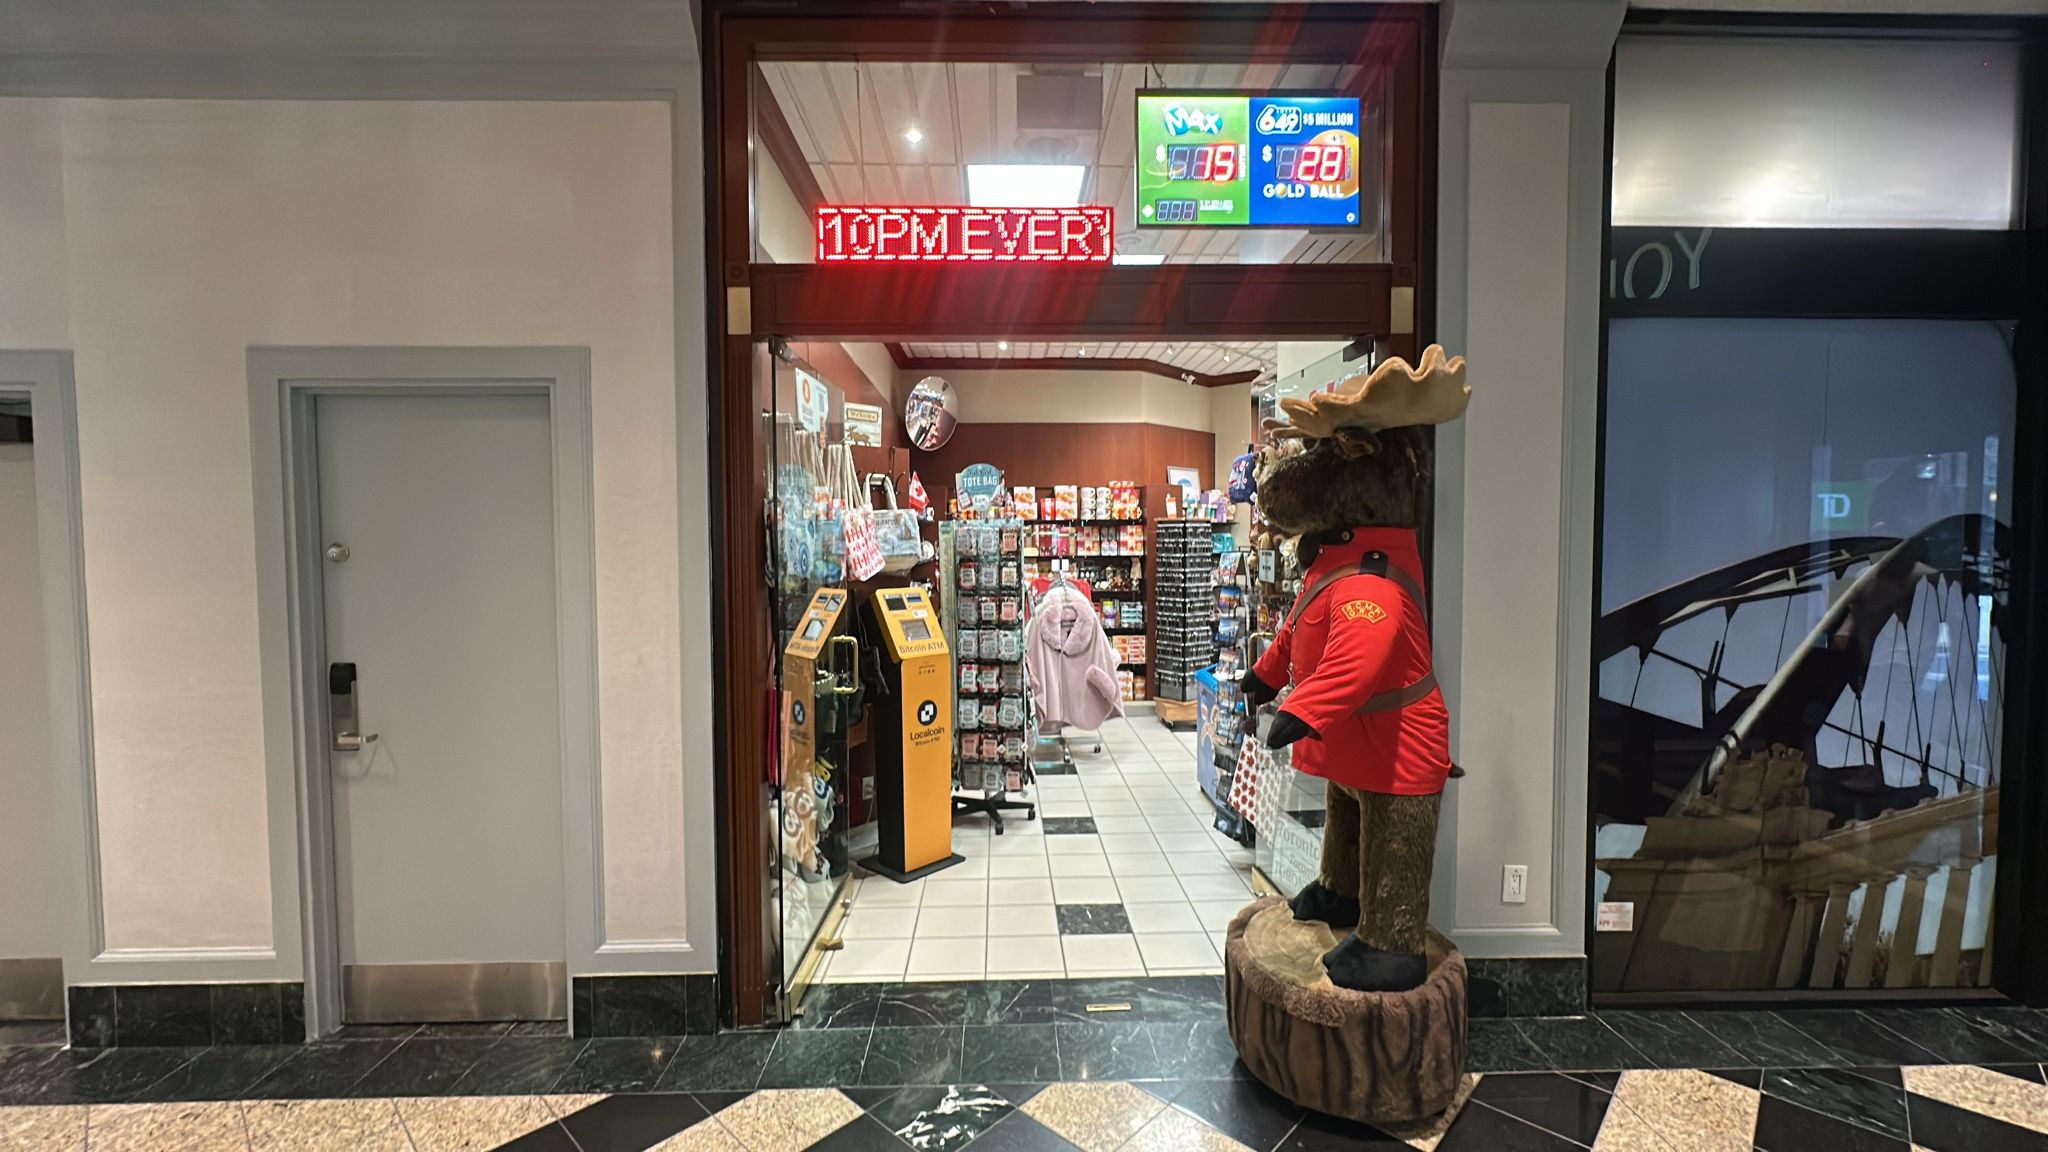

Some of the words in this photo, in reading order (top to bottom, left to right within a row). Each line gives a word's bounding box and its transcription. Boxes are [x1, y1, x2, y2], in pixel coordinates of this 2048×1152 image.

[1315, 112, 1353, 126] MILLION
[1297, 146, 1342, 181] 28
[1263, 183, 1305, 198] GOLD
[1310, 184, 1344, 198] BALL
[826, 214, 947, 254] 10PM
[963, 476, 981, 487] TOTE
[983, 475, 997, 486] BAG
[1816, 493, 1851, 518] TD
[900, 643, 926, 653] Bitcoin
[928, 641, 945, 651] ATM
[910, 726, 945, 741] Localcoin
